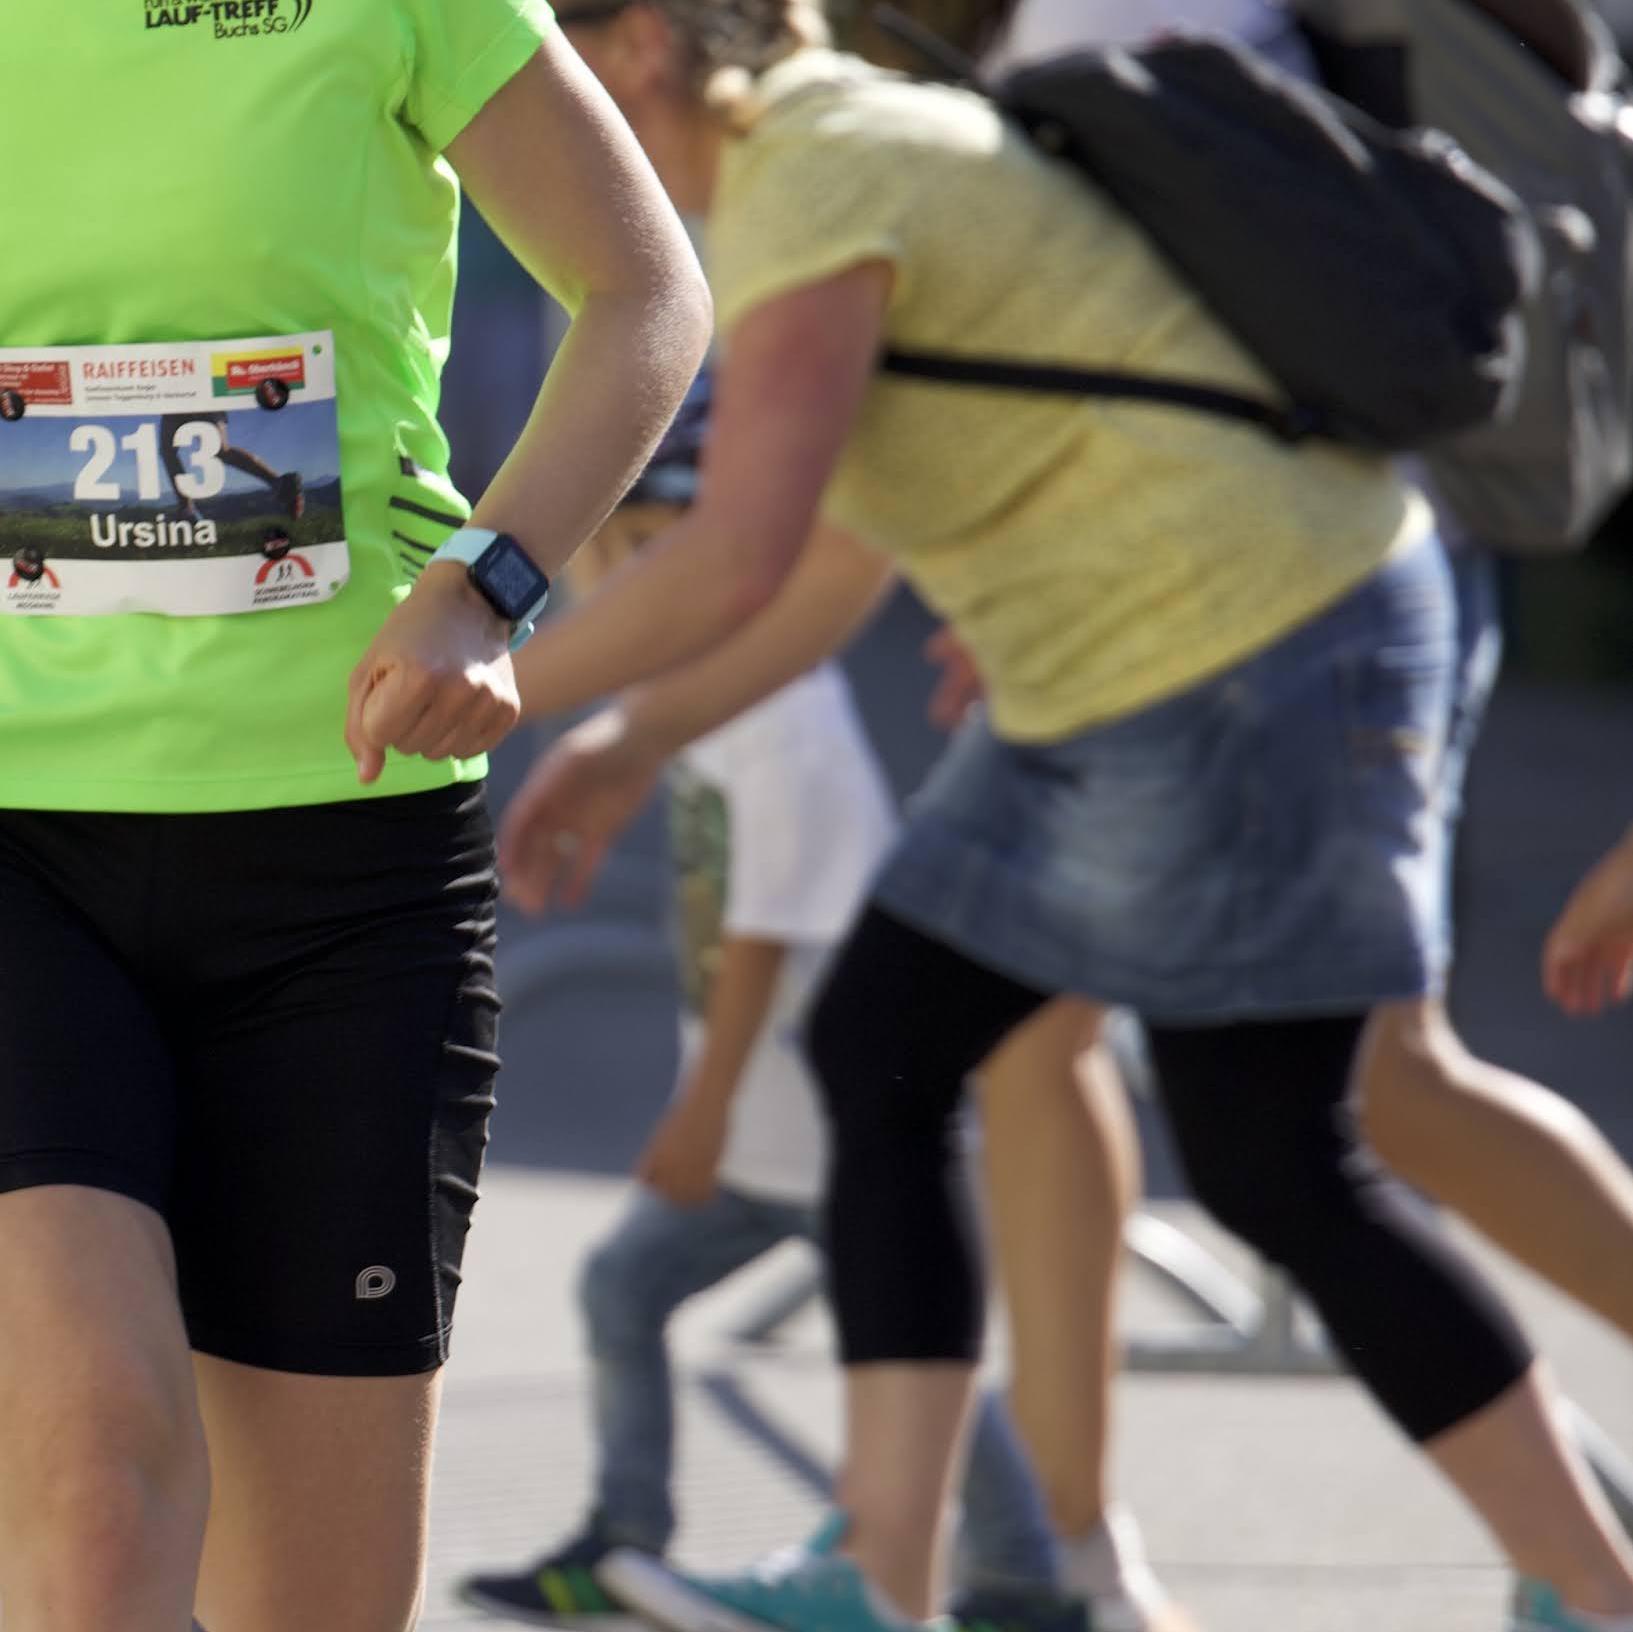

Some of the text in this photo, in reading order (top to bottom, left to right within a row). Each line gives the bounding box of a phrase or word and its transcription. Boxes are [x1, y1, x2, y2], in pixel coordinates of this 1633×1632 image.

[215, 16, 288, 39] Buchs SG
[83, 358, 195, 379] RAIFFEISEN
[70, 422, 225, 501] 213
[90, 514, 218, 549] Ursina
